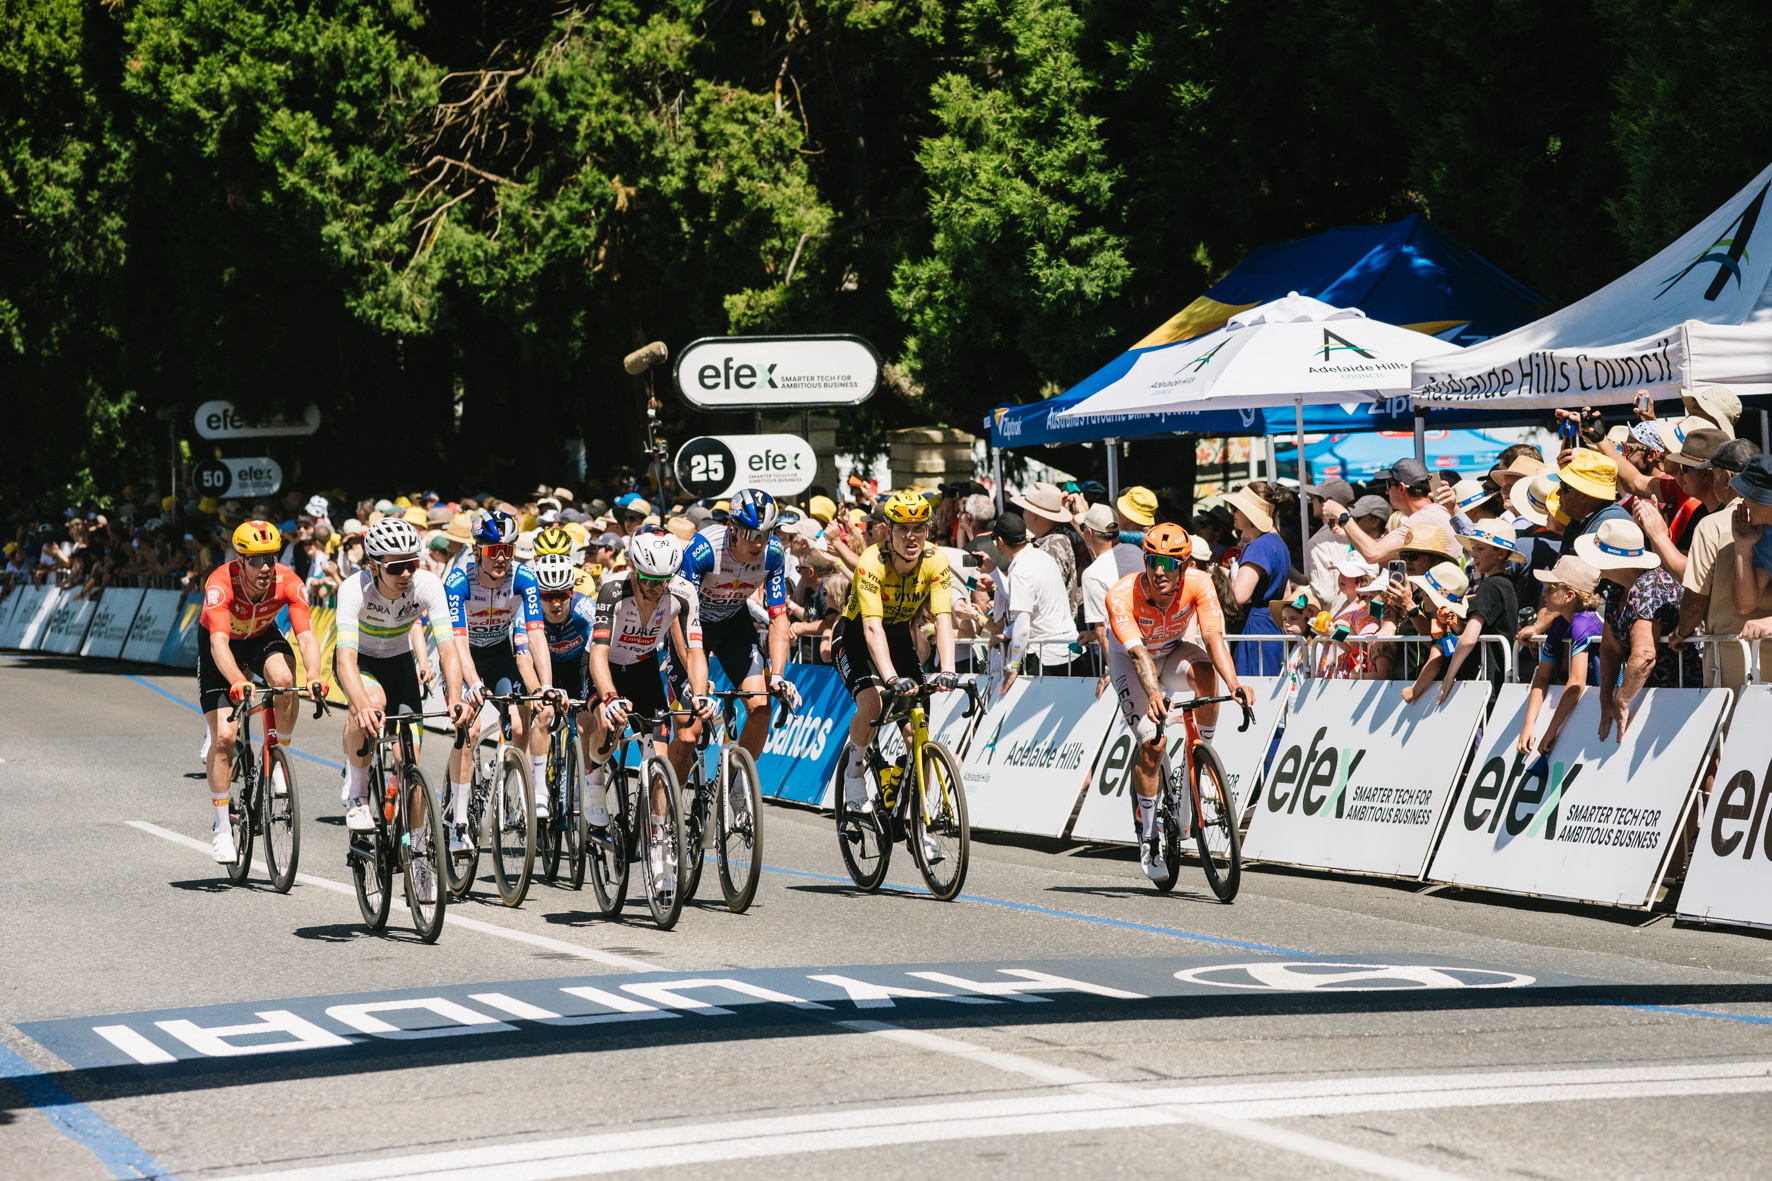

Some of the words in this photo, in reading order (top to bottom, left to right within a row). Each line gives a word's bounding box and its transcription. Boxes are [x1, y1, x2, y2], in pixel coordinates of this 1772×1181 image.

[698, 357, 778, 390] efex
[1308, 363, 1376, 375] Adelaide
[1378, 361, 1409, 371] Hills
[1518, 351, 1571, 395] Hills
[1576, 338, 1674, 392] Council
[1003, 415, 1022, 441] Ziptrak
[202, 470, 224, 487] 50
[238, 466, 273, 481] efex
[691, 454, 725, 482] 25
[748, 449, 801, 471] efex
[692, 542, 710, 558] BORA
[446, 571, 463, 587] BORA
[526, 586, 539, 615] BOSS
[702, 587, 751, 599] RedBu
[894, 590, 926, 603] VISMA
[449, 594, 460, 622] BOSS
[1111, 596, 1134, 635] INEOS
[622, 625, 661, 637] UAE
[1115, 674, 1140, 726] INEOS
[763, 705, 834, 762] Santos
[1003, 740, 1055, 768] Adelaide
[1055, 742, 1085, 770] Hills
[1267, 726, 1367, 819] efex
[1352, 786, 1392, 803] SMARTER
[1393, 789, 1417, 805] TECH
[1416, 790, 1433, 806] FOR
[1463, 751, 1583, 840] efex
[1345, 805, 1393, 823] AMBITIOUS
[1392, 808, 1432, 826] BUSINESS
[1566, 804, 1613, 824] SMARTER
[1611, 807, 1643, 826] TECH
[1642, 809, 1662, 828] FOR
[1557, 825, 1613, 847] AMBITIOUS
[1611, 829, 1661, 849] BUSINESS
[92, 968, 1150, 1066] HYUNDAI
